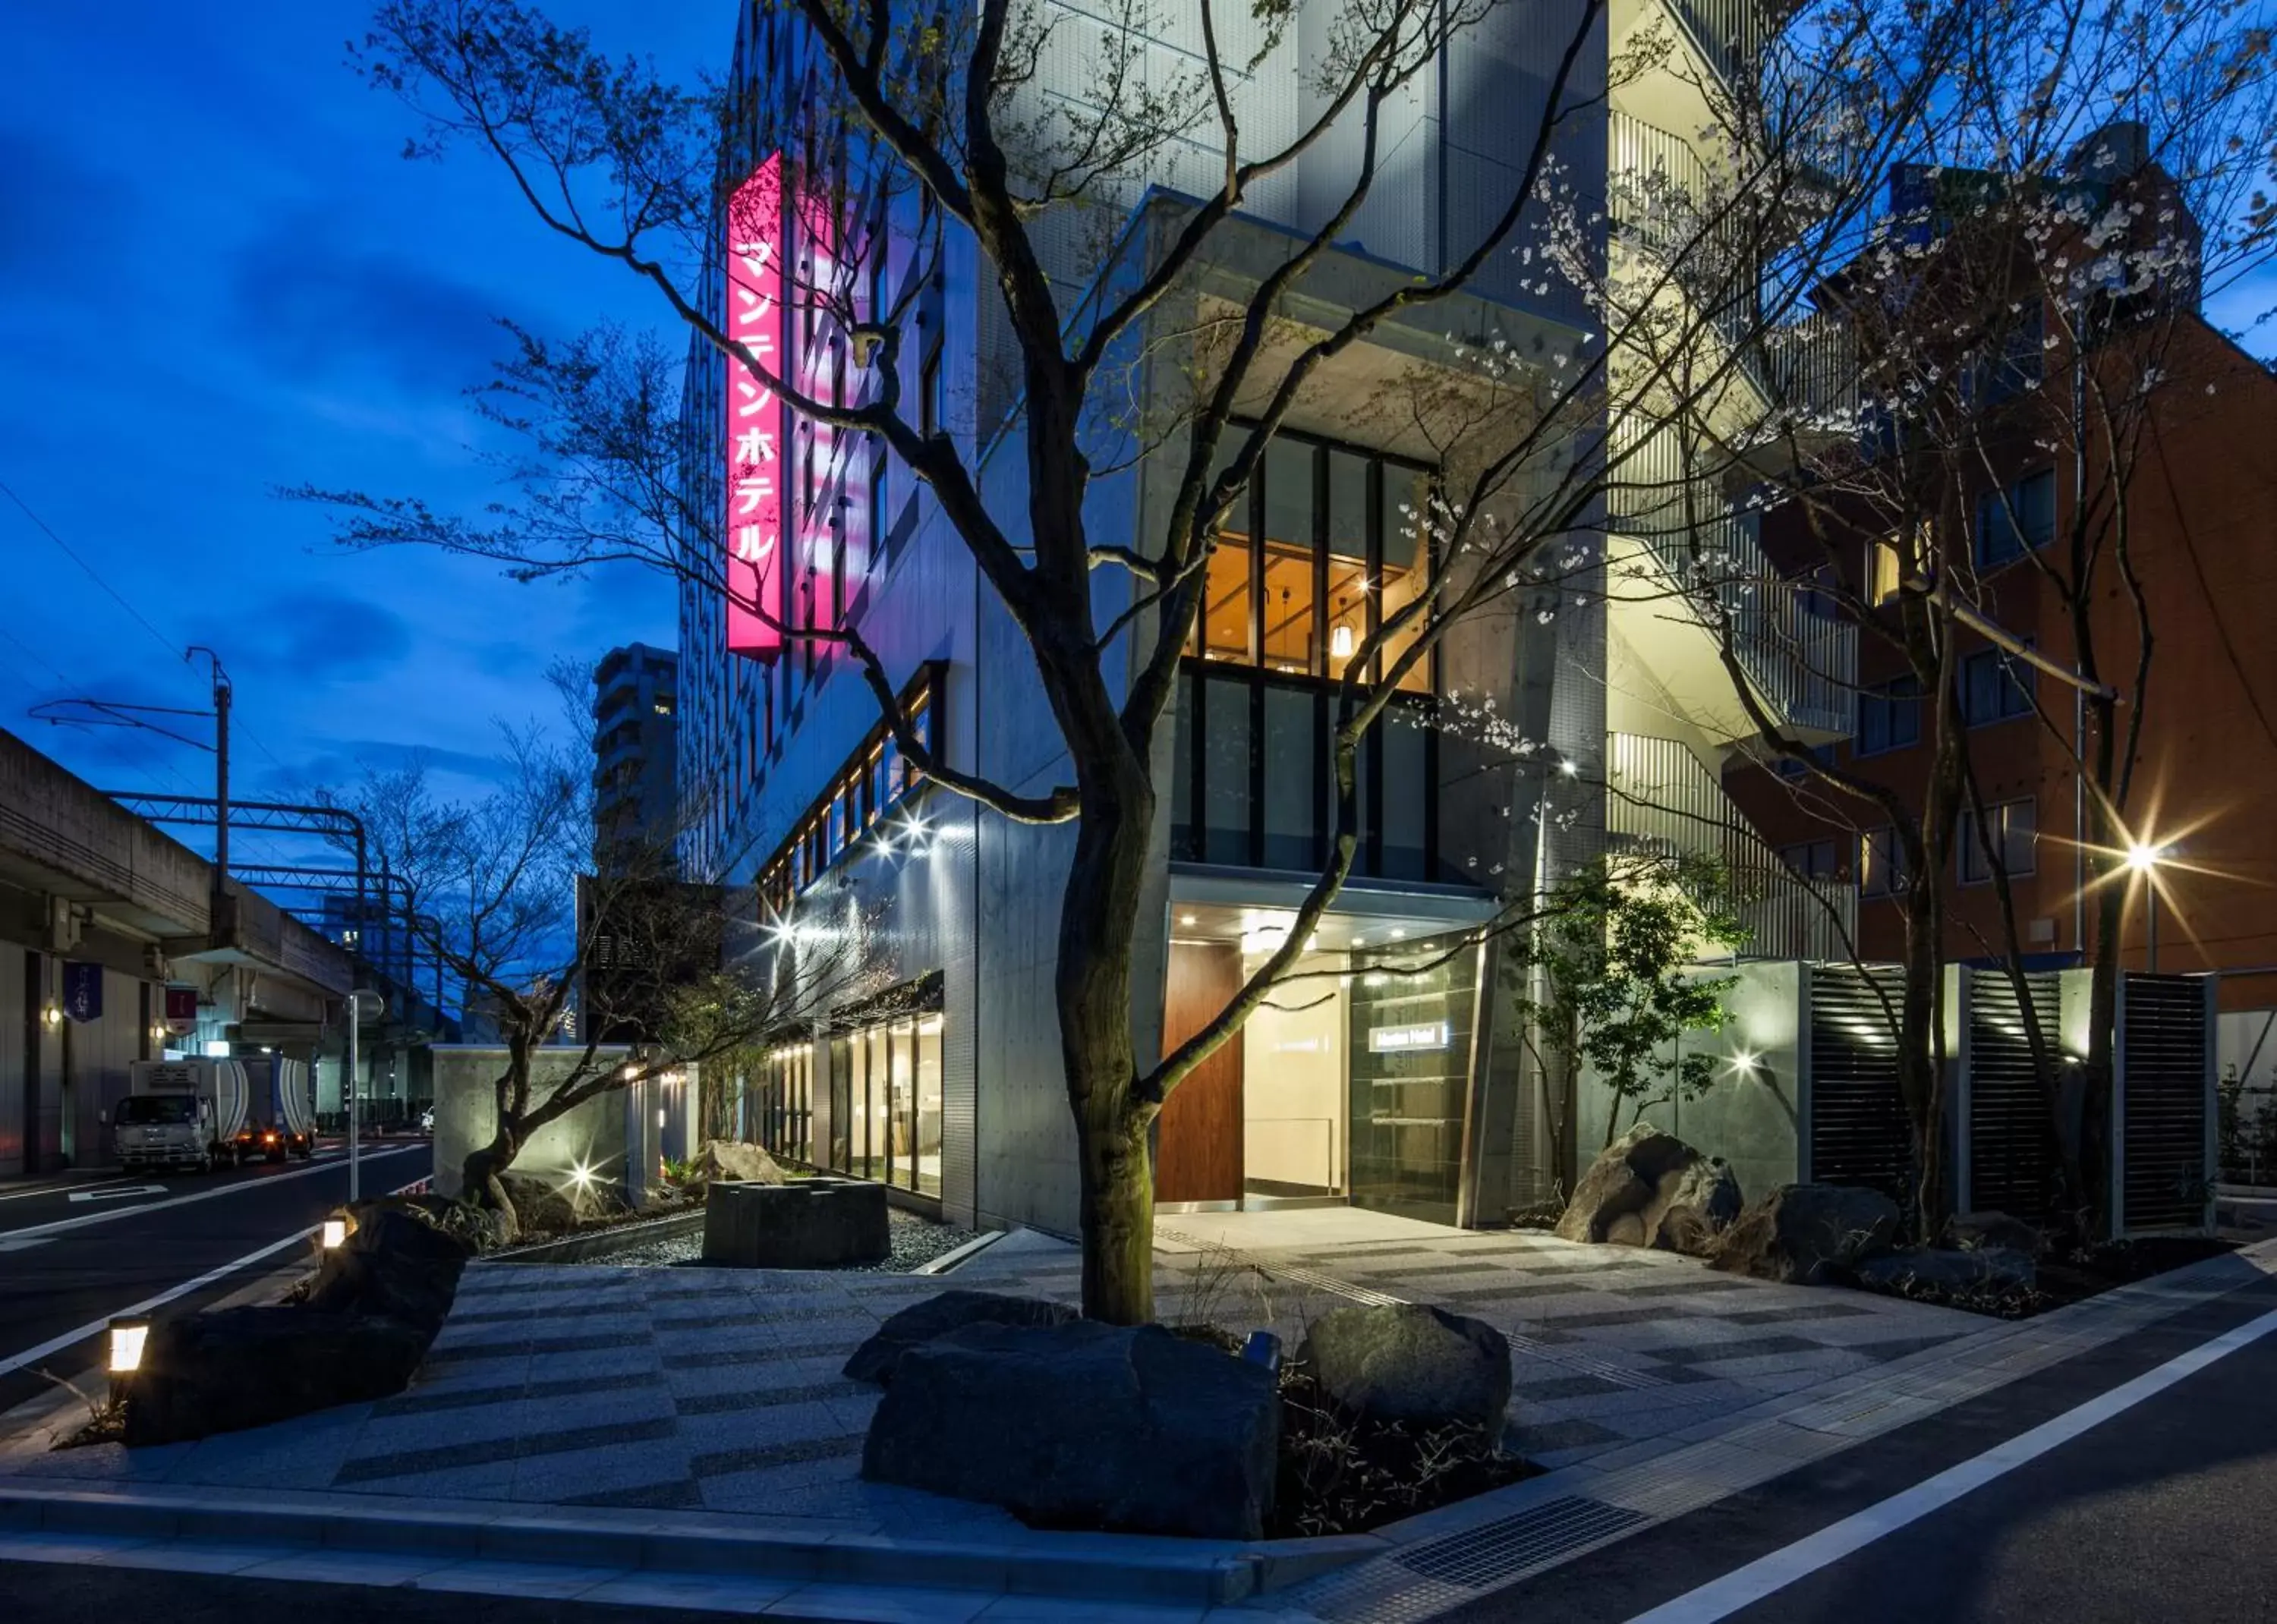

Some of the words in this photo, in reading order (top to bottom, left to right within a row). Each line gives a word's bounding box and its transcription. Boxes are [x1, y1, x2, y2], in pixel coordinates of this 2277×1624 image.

[735, 242, 775, 559] マンテンホテル
